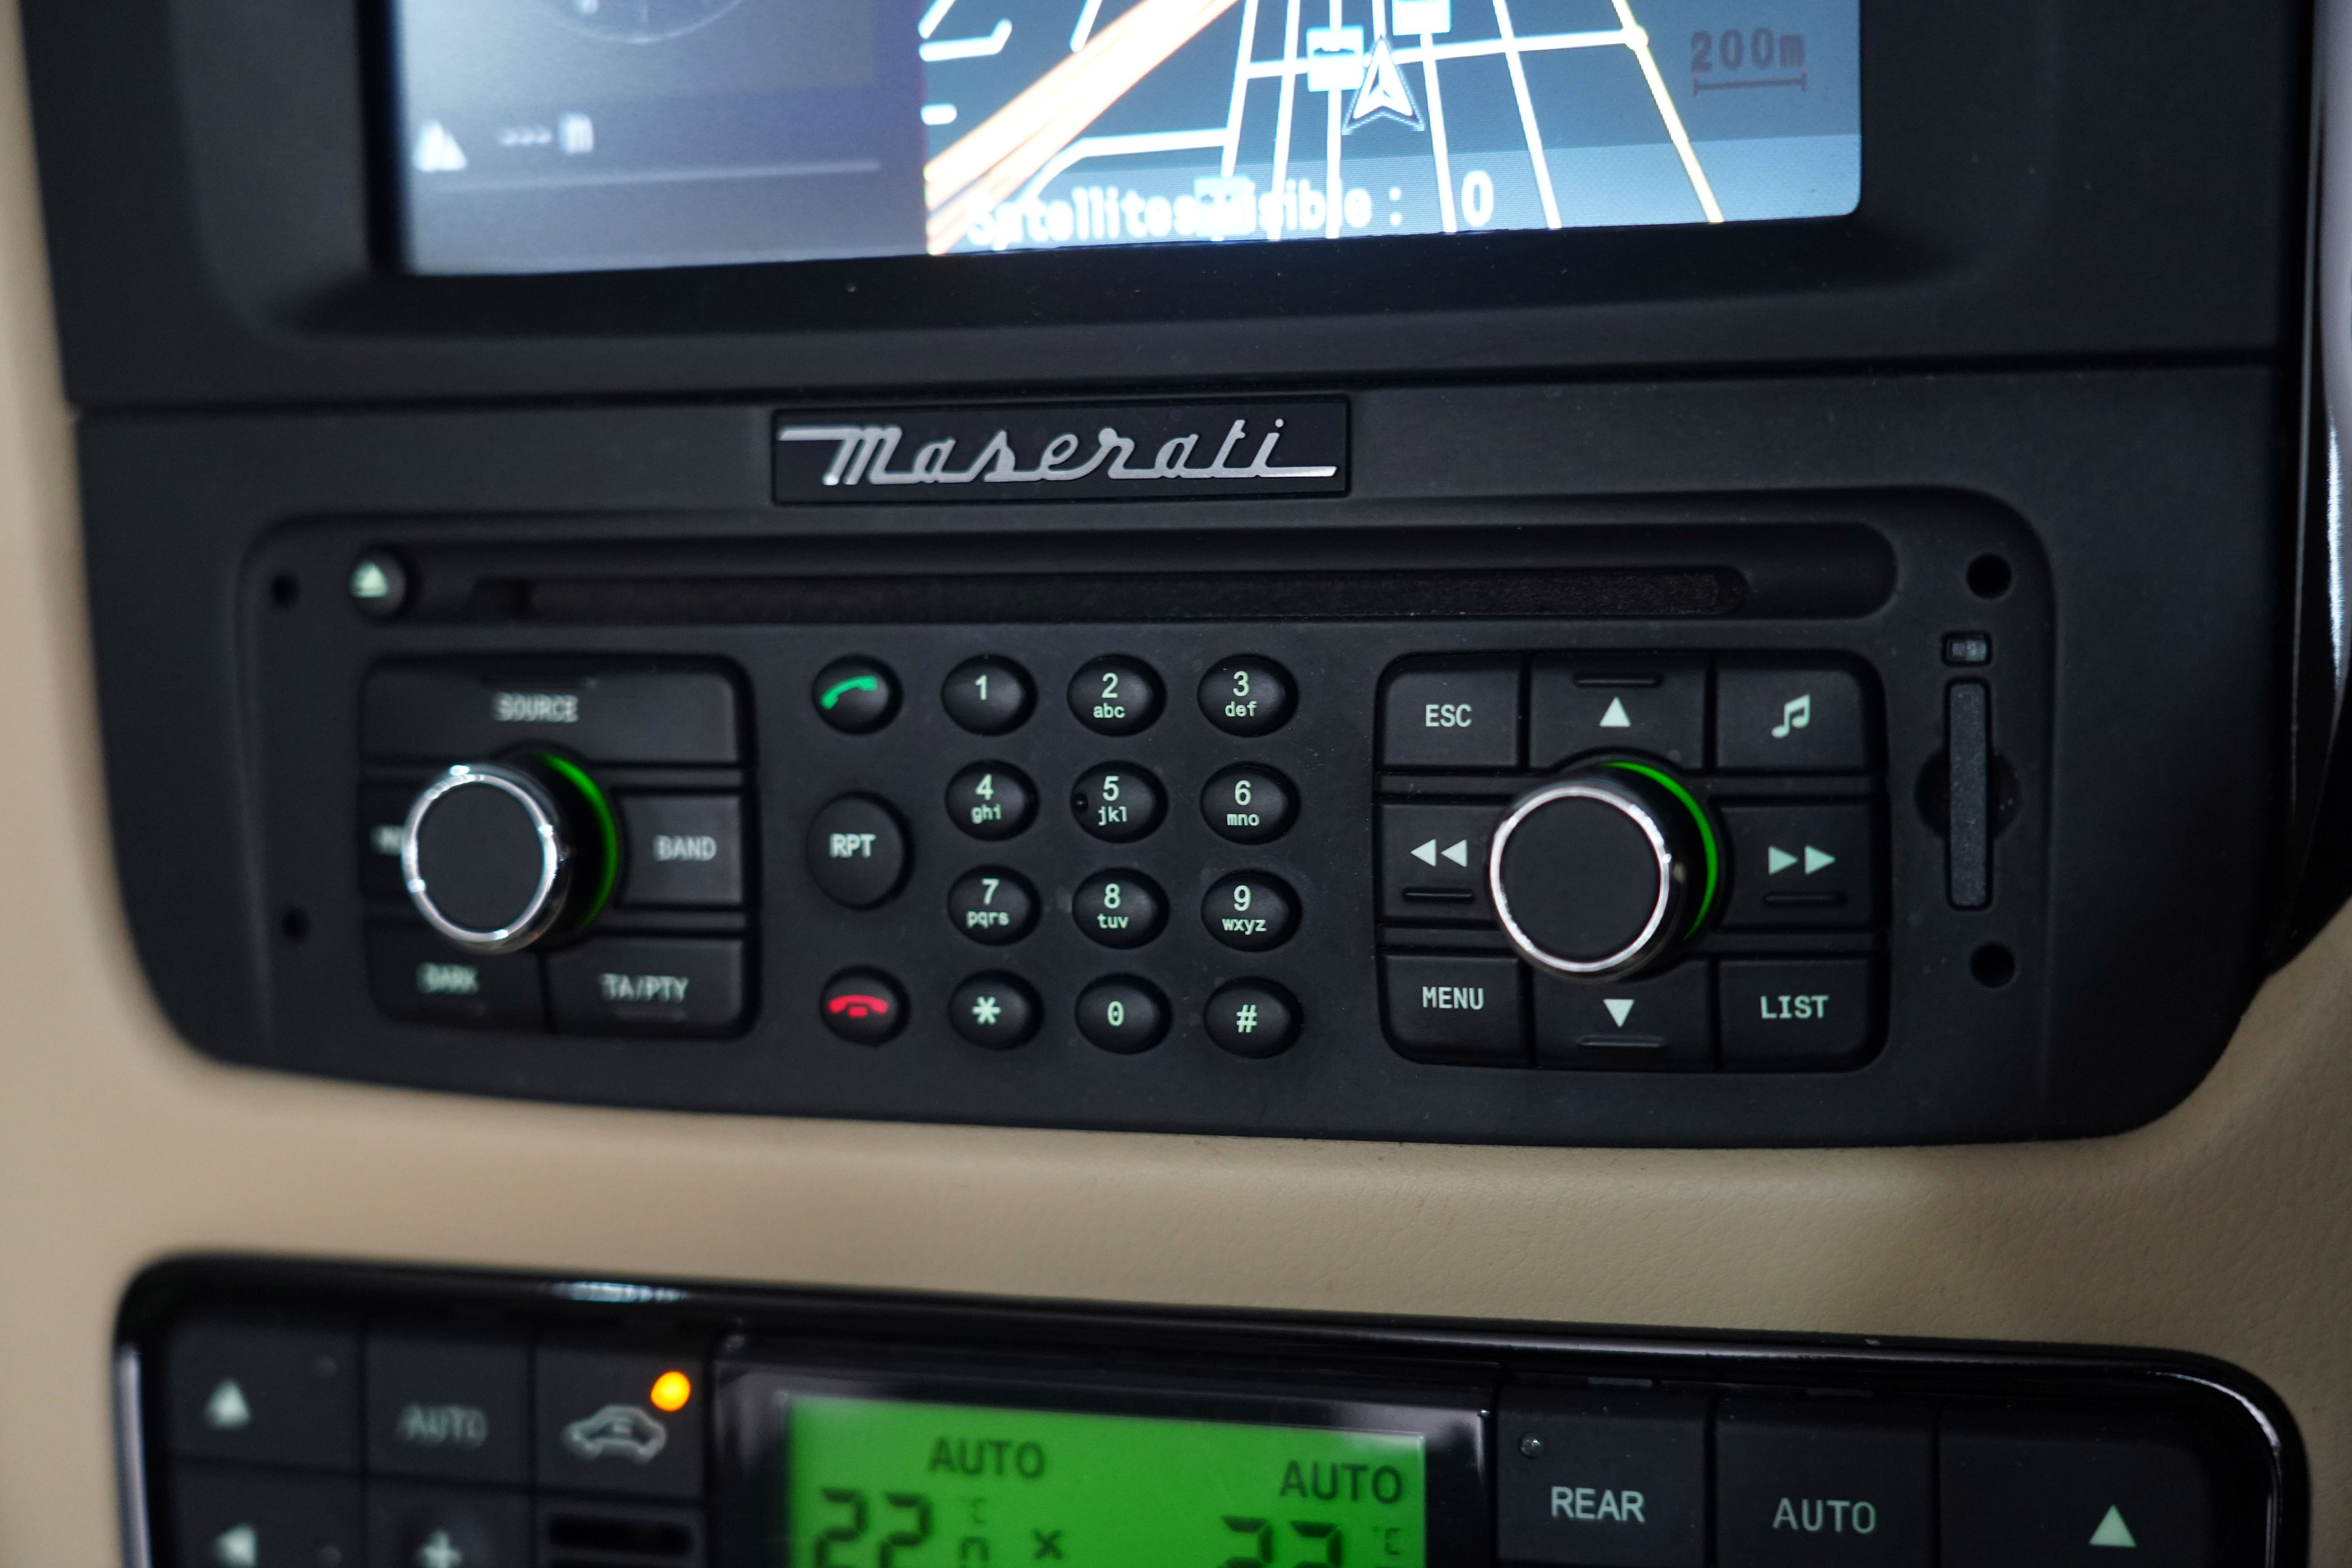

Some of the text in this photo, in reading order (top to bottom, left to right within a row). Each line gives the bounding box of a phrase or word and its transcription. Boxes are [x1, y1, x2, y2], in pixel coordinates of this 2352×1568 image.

[1690, 27, 1806, 73] 200m
[1461, 171, 1494, 227] 0
[780, 418, 1337, 486] Maserati
[975, 675, 988, 701] 1
[1102, 673, 1118, 699] 2
[1233, 671, 1250, 697] 3
[496, 693, 578, 723] SOURCE
[1093, 702, 1125, 719] abc
[1225, 701, 1257, 717] def
[1425, 704, 1472, 728] ESC
[975, 774, 995, 801] 4
[1103, 775, 1119, 801] 5
[1234, 780, 1251, 806] 6
[971, 804, 1002, 824] ghi
[1098, 806, 1127, 826] jkl
[1226, 813, 1260, 826] mno
[655, 835, 717, 862] BAND
[829, 833, 876, 858] RPT
[982, 878, 999, 905] 7
[1104, 883, 1121, 909] 8
[1234, 885, 1251, 912] 9
[966, 911, 1010, 928] pqrs
[1097, 913, 1129, 929] tuv
[1221, 918, 1267, 935] wxyz
[600, 973, 689, 1001] TA/PTY
[1422, 986, 1484, 1010] MENU
[1107, 1001, 1124, 1027] 0
[1236, 1004, 1258, 1033] #
[1760, 995, 1829, 1019] LIST
[400, 1403, 488, 1446] AUTO
[928, 1436, 1046, 1481] AUTO
[1280, 1460, 1404, 1505] AUTO
[1550, 1486, 1645, 1523] REAR
[1772, 1497, 1876, 1534] AUTO
